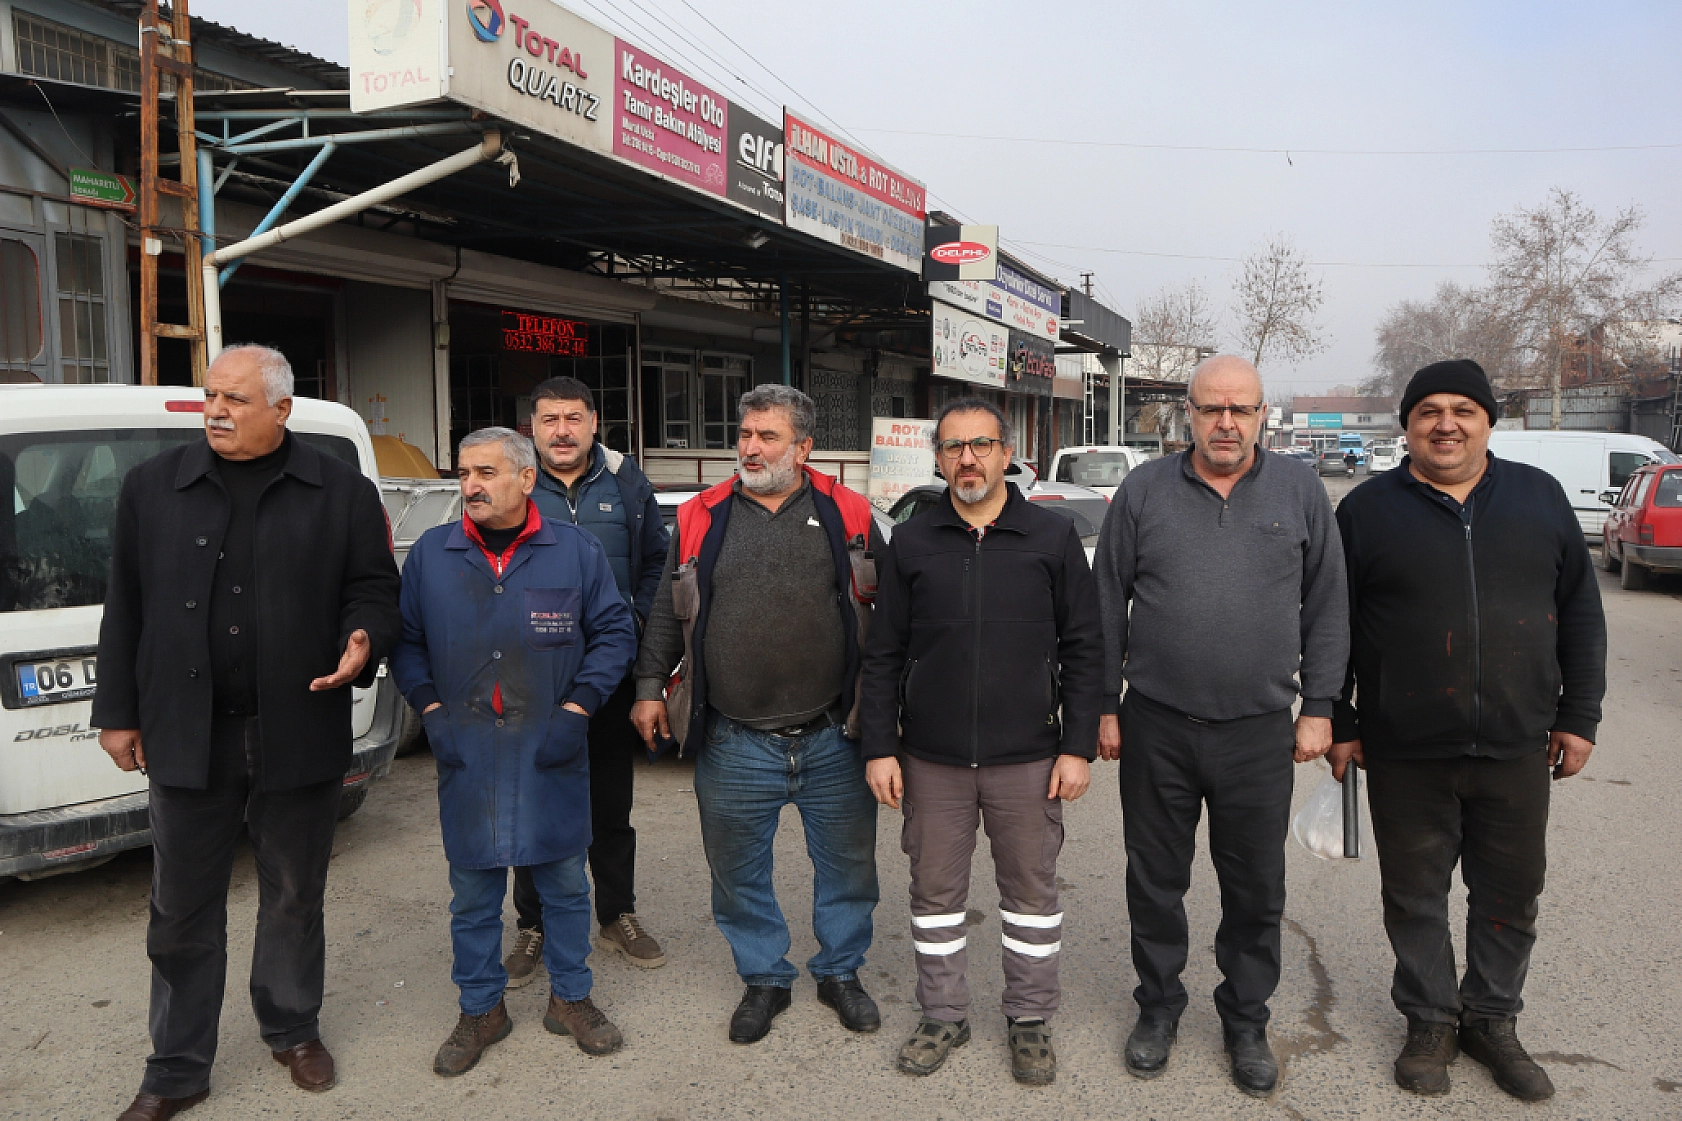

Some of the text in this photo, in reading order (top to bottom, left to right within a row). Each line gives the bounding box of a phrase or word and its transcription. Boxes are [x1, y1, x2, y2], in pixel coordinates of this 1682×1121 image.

[510, 13, 588, 79] TOTAL
[359, 67, 430, 94] TOTAL
[508, 57, 600, 122] QUARTZ
[622, 51, 724, 129] Kardeşler Oto
[623, 90, 652, 121] Tamir
[655, 105, 686, 137] Bakım
[869, 167, 889, 194] ROT
[938, 249, 983, 258] DELPHI
[517, 315, 575, 336] TELEFON
[505, 333, 533, 350] 0532
[557, 338, 570, 353] 22
[571, 340, 585, 355] 44
[891, 424, 921, 436] ROT
[23, 682, 37, 692] TR
[37, 663, 73, 691] 06
[13, 722, 89, 742] DOBL
